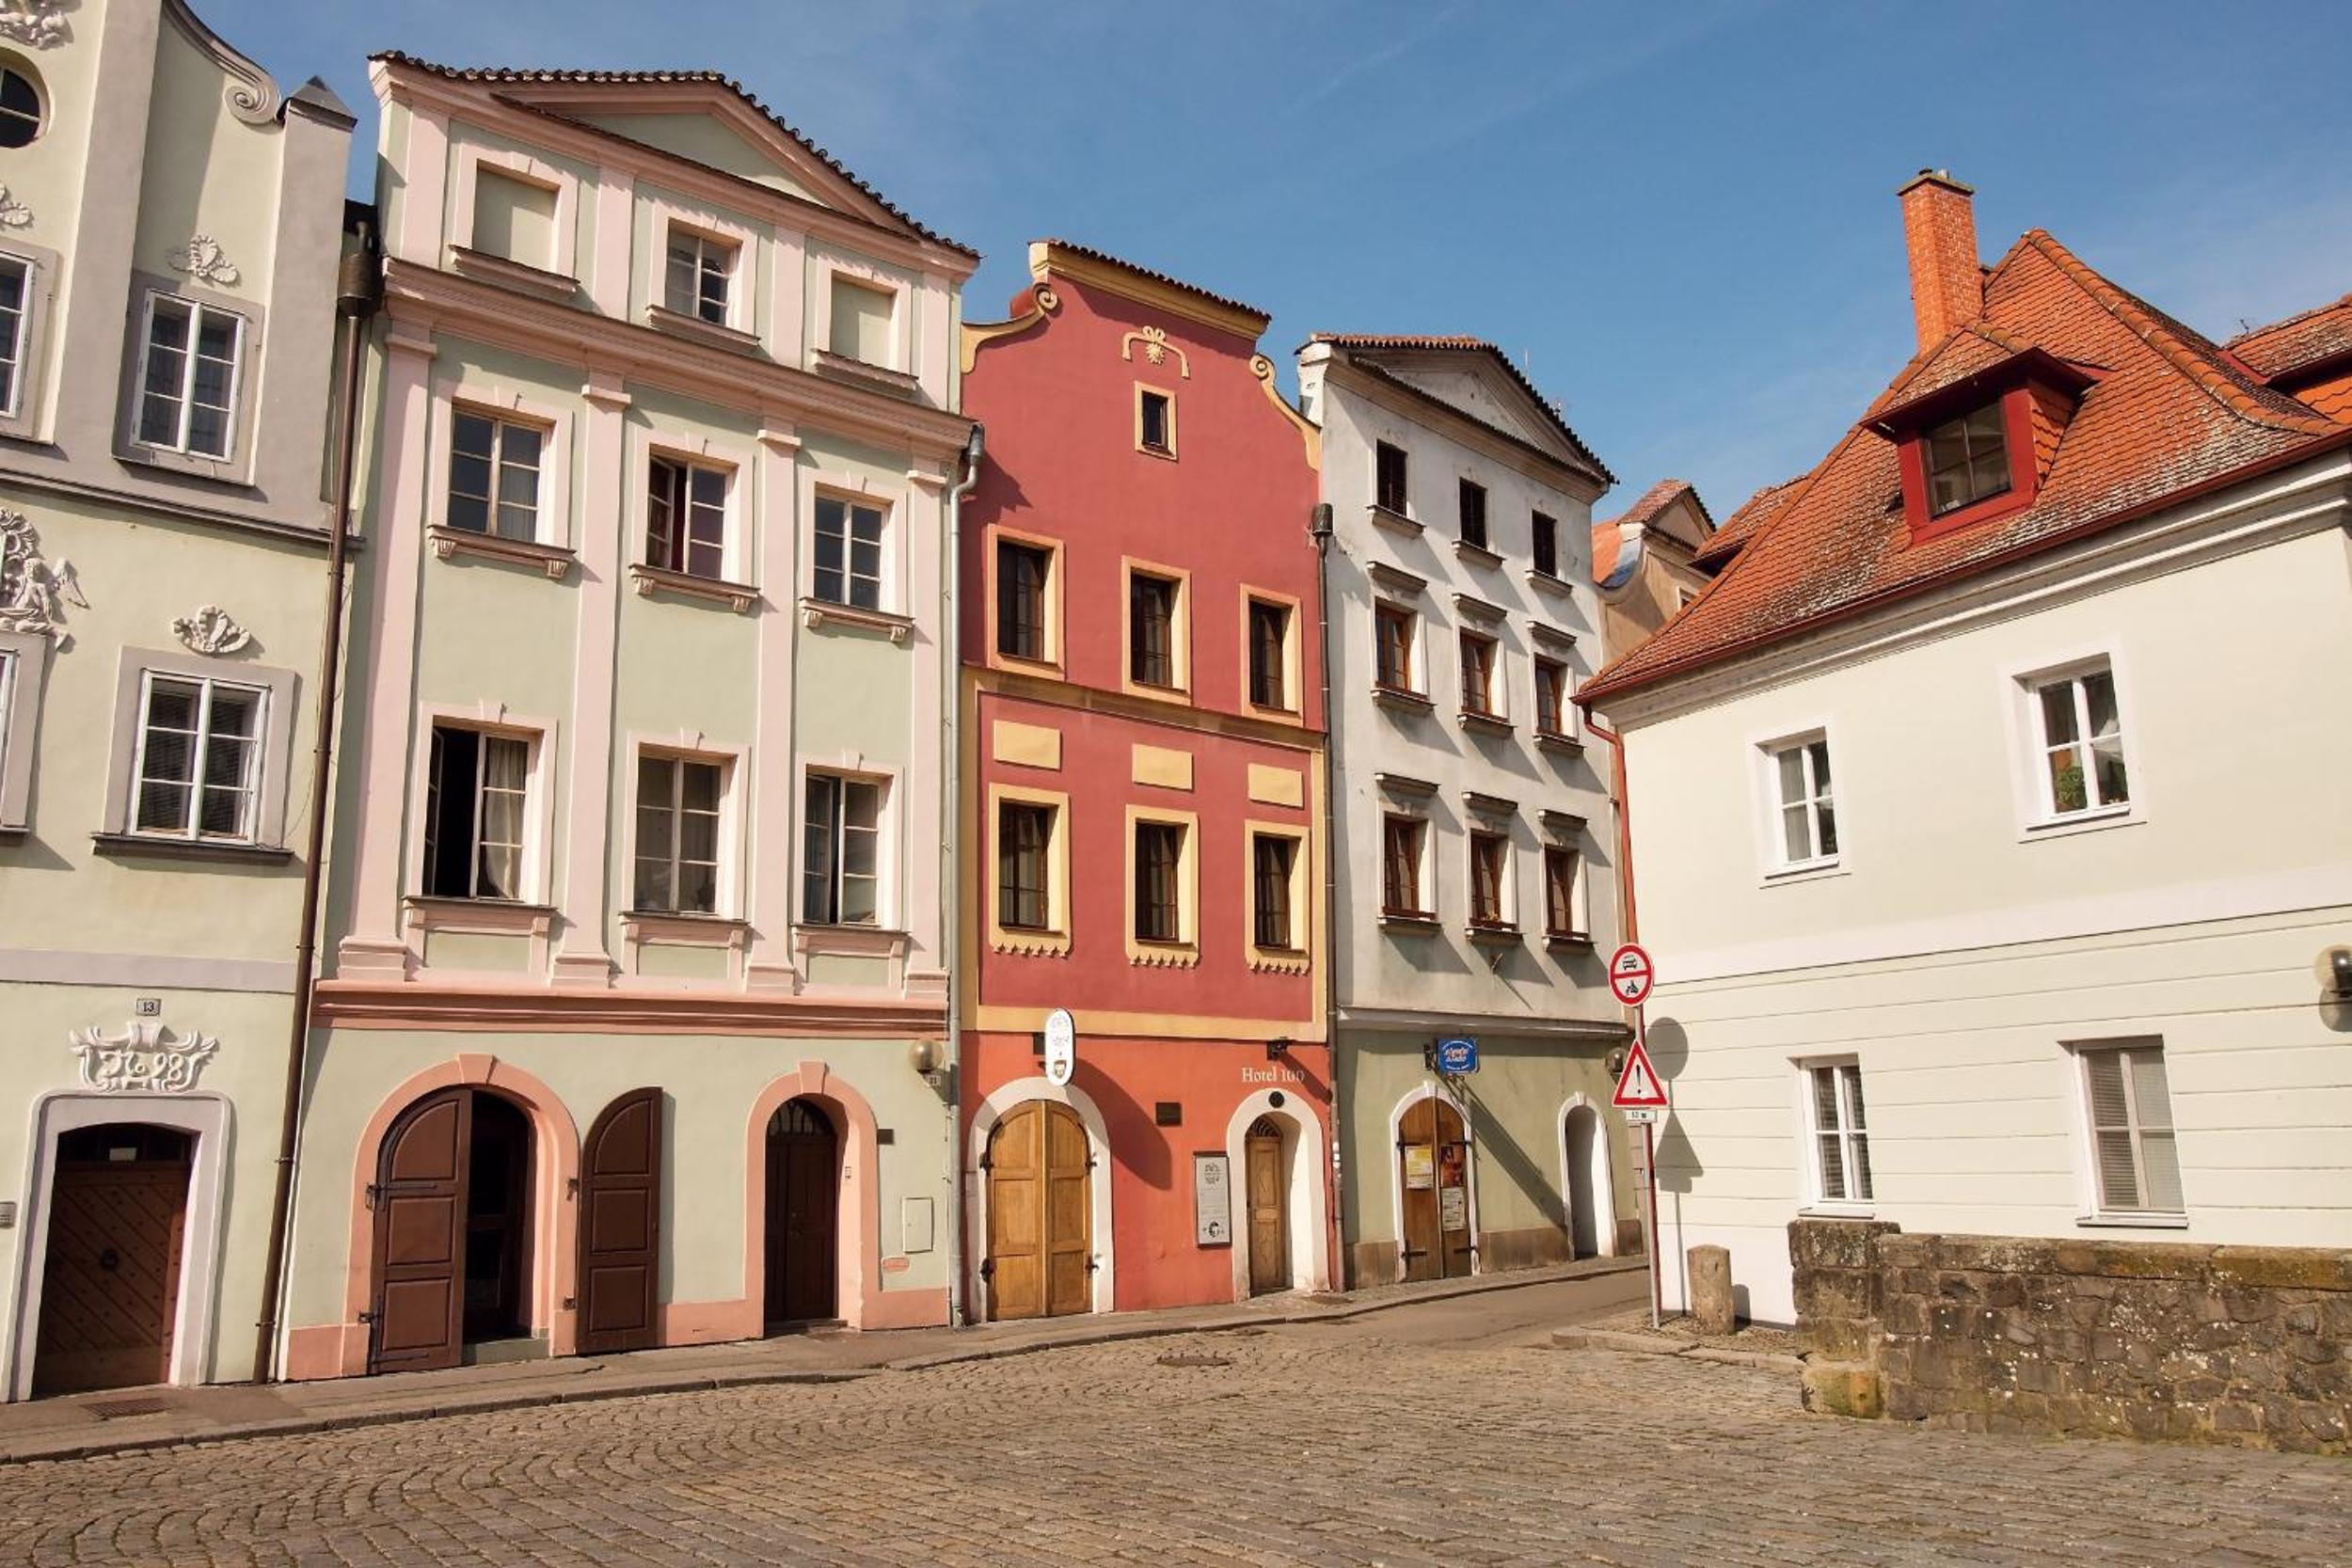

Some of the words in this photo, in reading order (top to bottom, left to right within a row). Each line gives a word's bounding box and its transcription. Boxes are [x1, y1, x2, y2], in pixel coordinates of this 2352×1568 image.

[143, 1001, 155, 1013] 13
[1242, 1066, 1278, 1083] Hotel
[1281, 1069, 1305, 1083] 100
